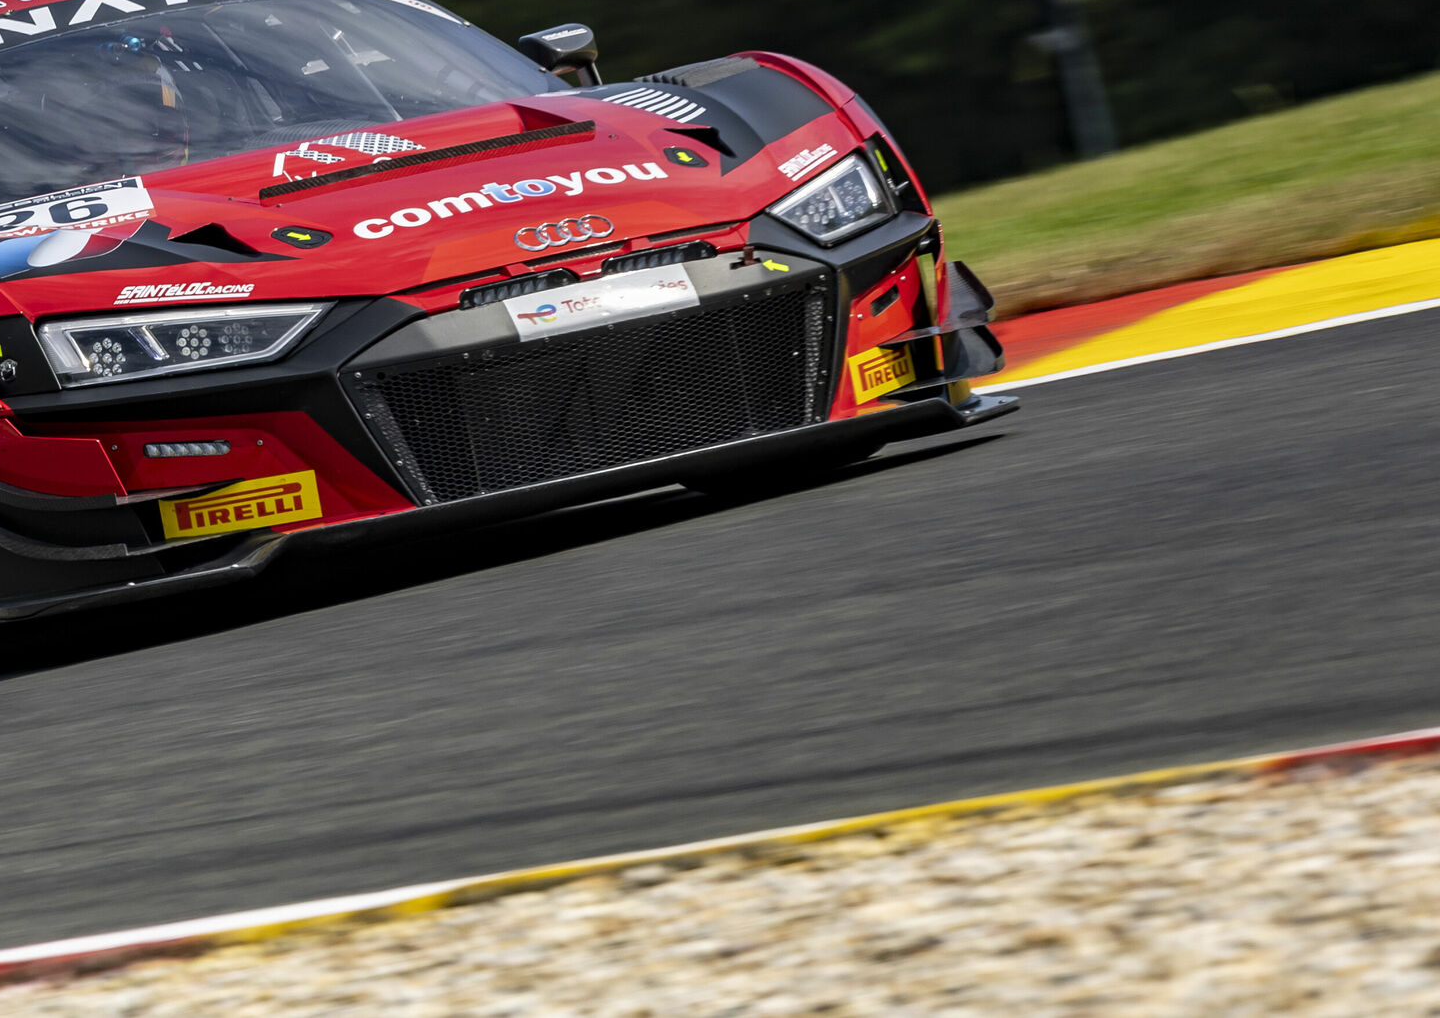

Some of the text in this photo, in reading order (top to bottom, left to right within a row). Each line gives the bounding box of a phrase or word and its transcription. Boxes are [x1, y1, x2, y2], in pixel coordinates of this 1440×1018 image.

[353, 162, 669, 240] comtoyou
[204, 283, 255, 295] RACING
[857, 348, 910, 392] PIRELLI
[174, 482, 304, 530] PIRELLI
